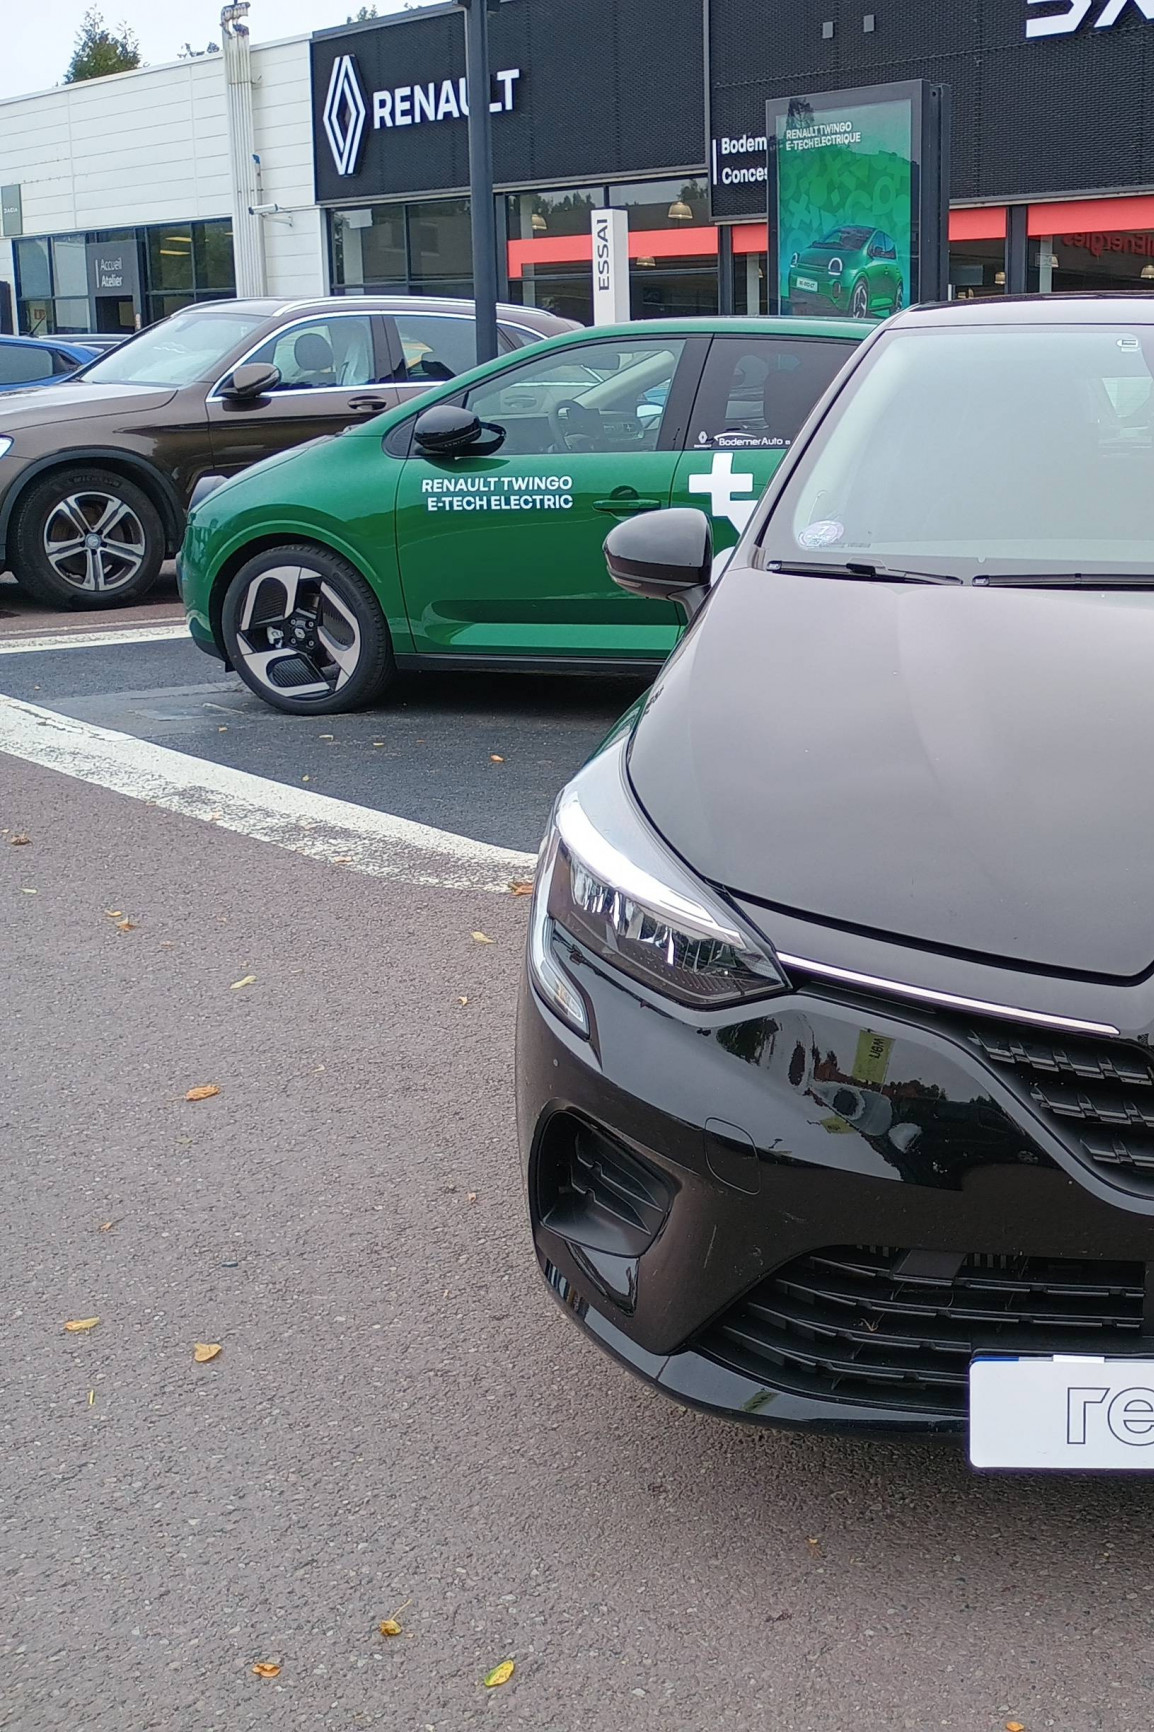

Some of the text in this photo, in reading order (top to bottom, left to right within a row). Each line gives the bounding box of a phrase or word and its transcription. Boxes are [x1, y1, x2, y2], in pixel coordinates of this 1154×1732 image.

[785, 121, 852, 140] RENAULT TWINGO
[721, 134, 767, 155] Bodem
[785, 132, 861, 151] E-TECH ELECTRIQUE
[721, 165, 768, 185] Conces
[100, 256, 123, 271] Accueil
[597, 218, 610, 292] ESSAI
[101, 274, 123, 288] Atelier
[422, 475, 573, 493] RENAULT TWINGO
[427, 494, 573, 512] E-TECH ELECTRIC
